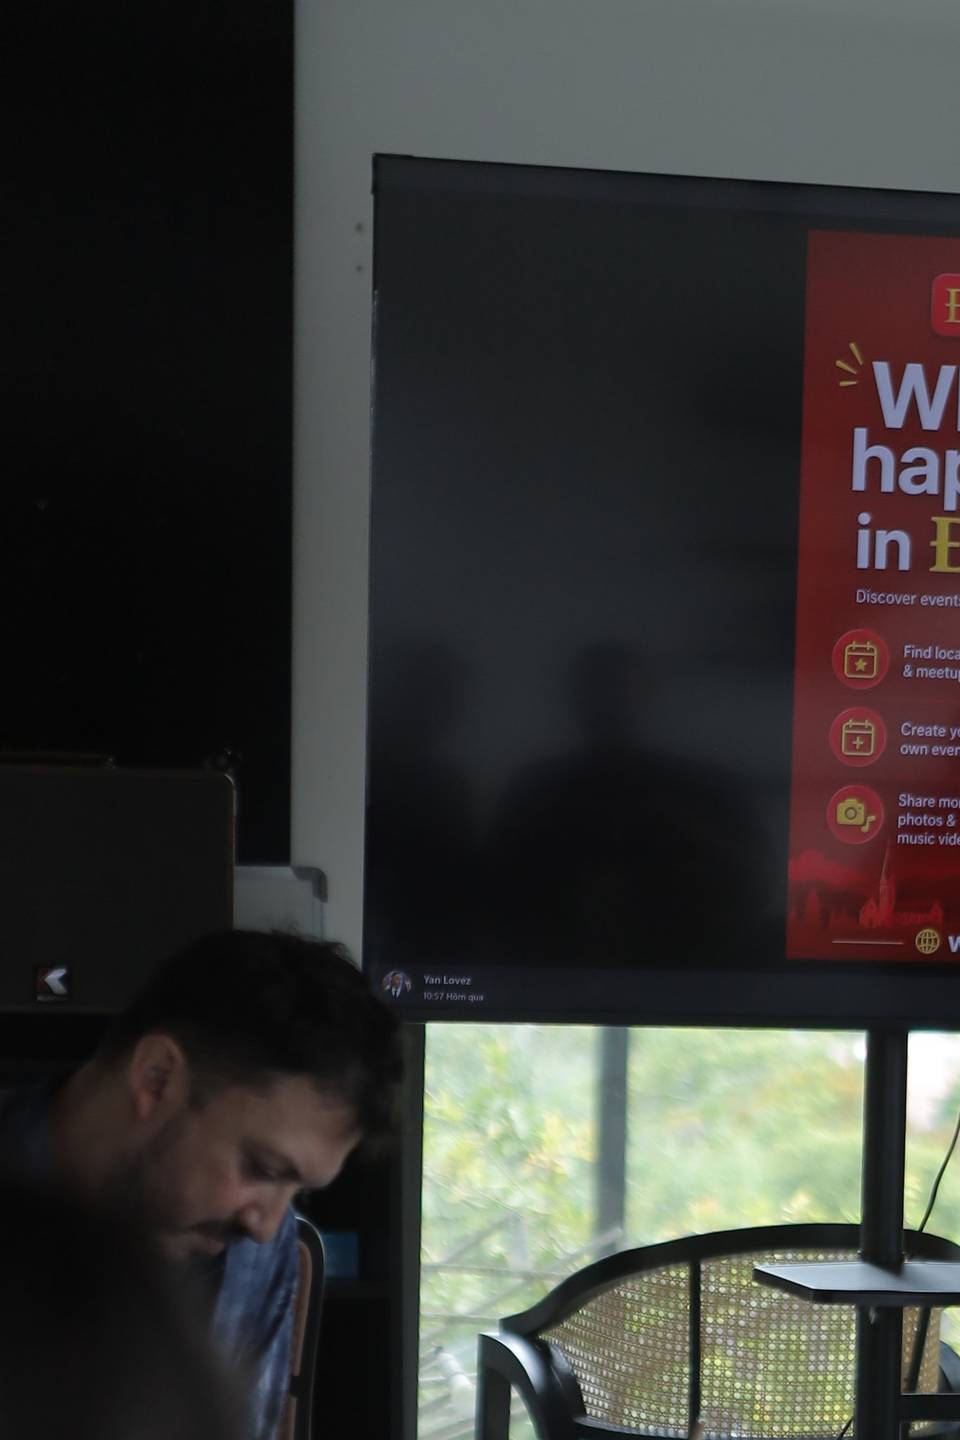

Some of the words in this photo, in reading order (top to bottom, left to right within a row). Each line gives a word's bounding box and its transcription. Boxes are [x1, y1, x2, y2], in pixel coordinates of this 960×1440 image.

[857, 512, 911, 571] in
[856, 588, 917, 606] Discover
[903, 645, 933, 660] Find
[903, 664, 913, 678] &
[900, 722, 946, 738] Create
[900, 744, 929, 756] own
[898, 793, 936, 809] Share
[897, 814, 944, 829] photos
[945, 814, 957, 828] &
[896, 832, 936, 846] music
